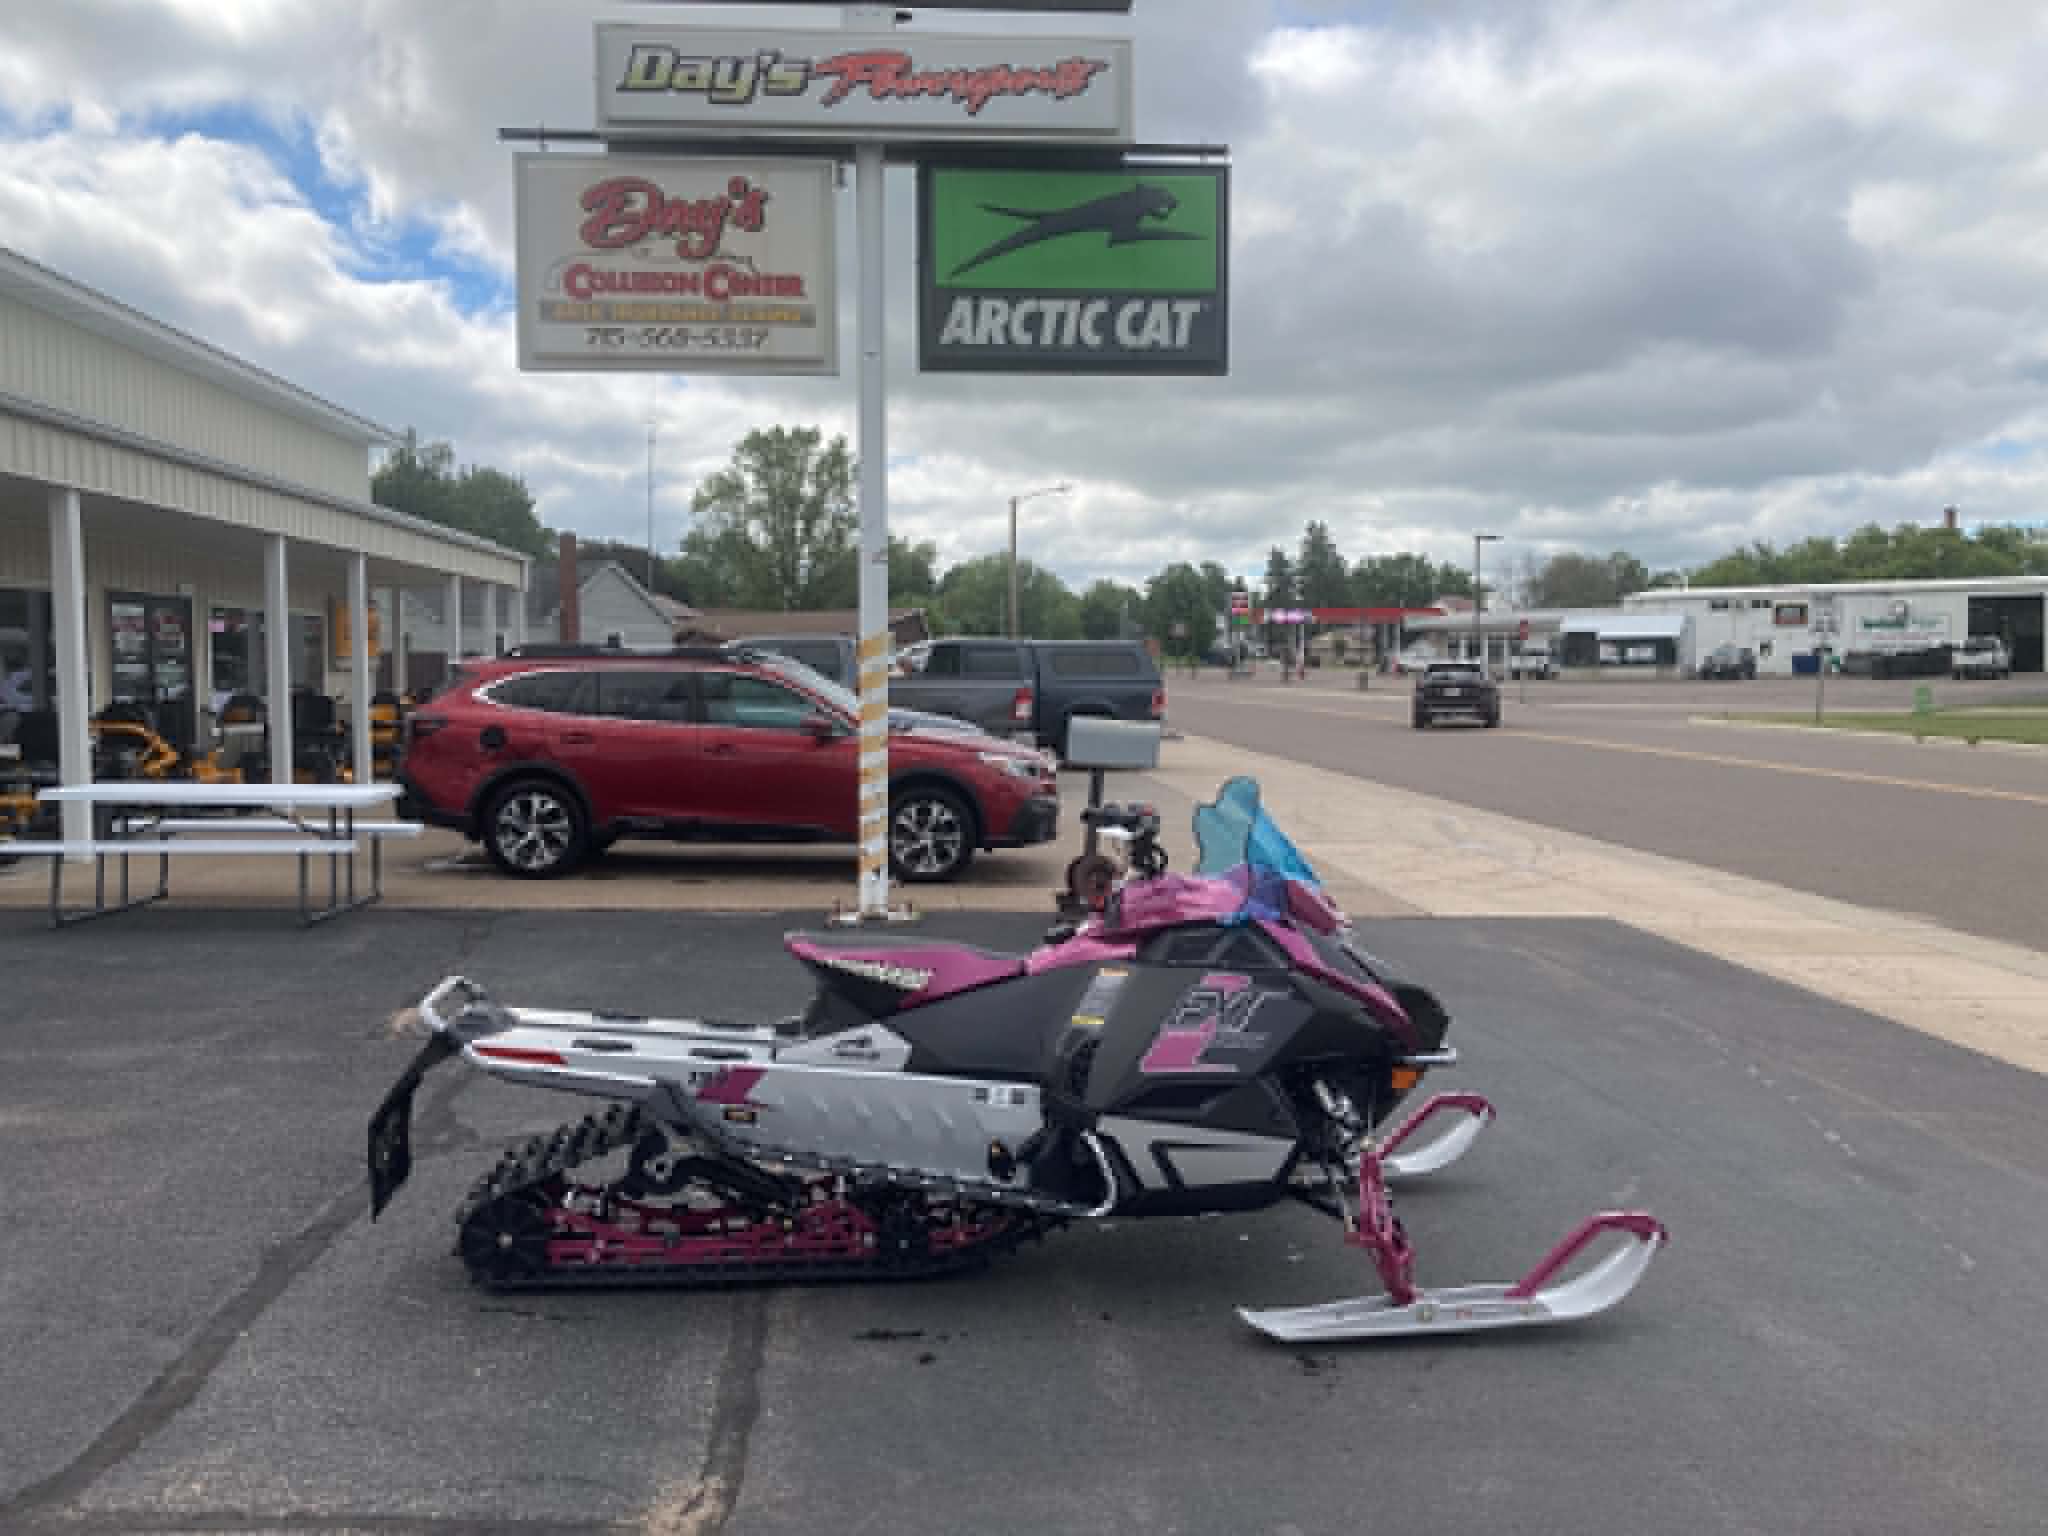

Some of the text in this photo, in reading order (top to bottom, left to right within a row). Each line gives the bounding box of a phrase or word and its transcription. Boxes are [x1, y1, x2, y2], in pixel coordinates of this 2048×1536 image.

[617, 44, 814, 104] Day's
[580, 175, 770, 260] Day's
[939, 297, 1201, 349] ARCTIC CAT
